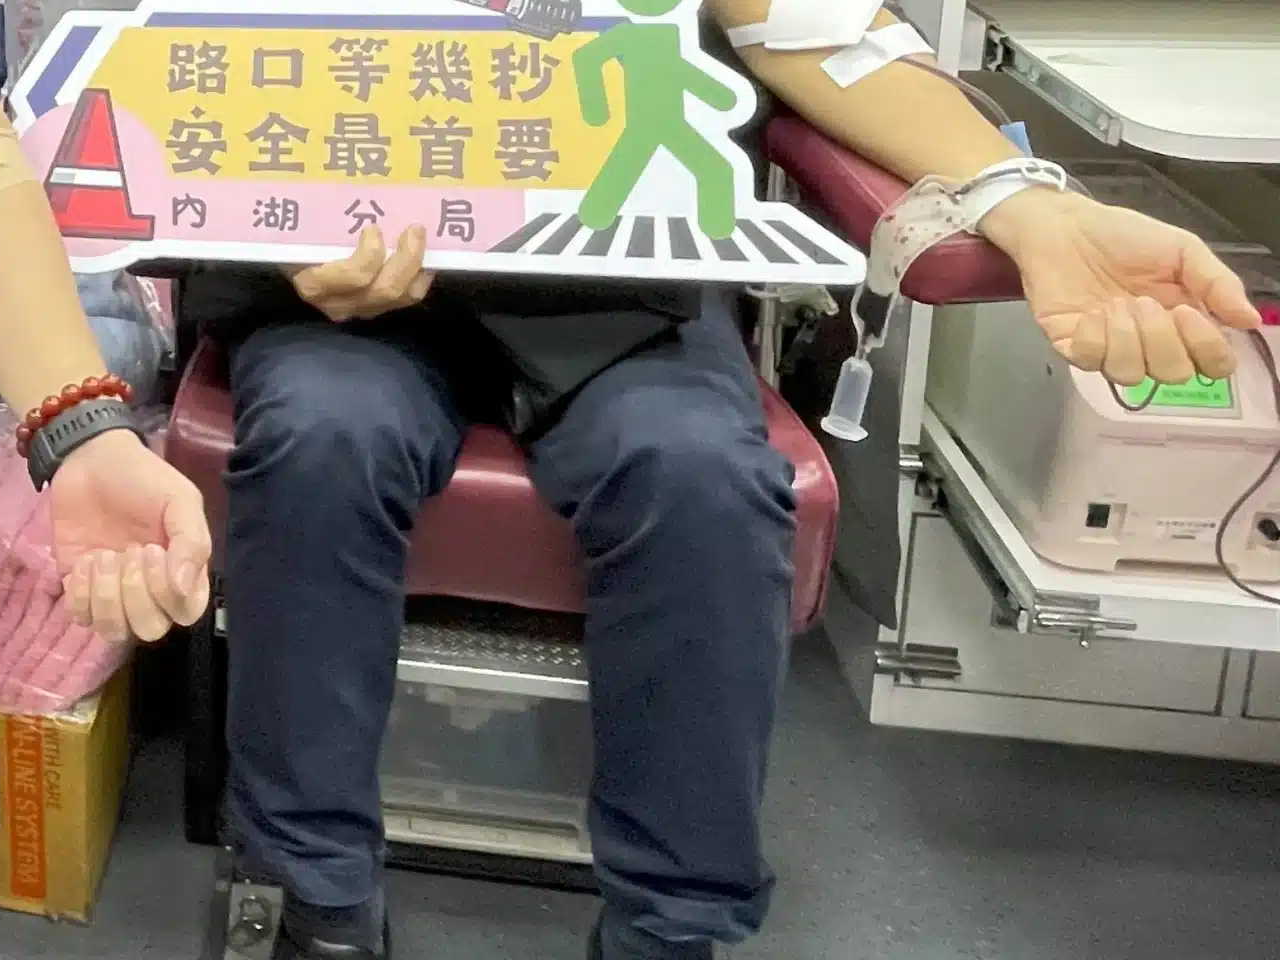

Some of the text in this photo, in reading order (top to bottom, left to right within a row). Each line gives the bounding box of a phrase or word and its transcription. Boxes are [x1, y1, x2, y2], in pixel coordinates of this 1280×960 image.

[166, 38, 561, 103] 路口等幾秒
[165, 105, 561, 181] 安全最首要
[14, 798, 40, 885] SYSTEM
